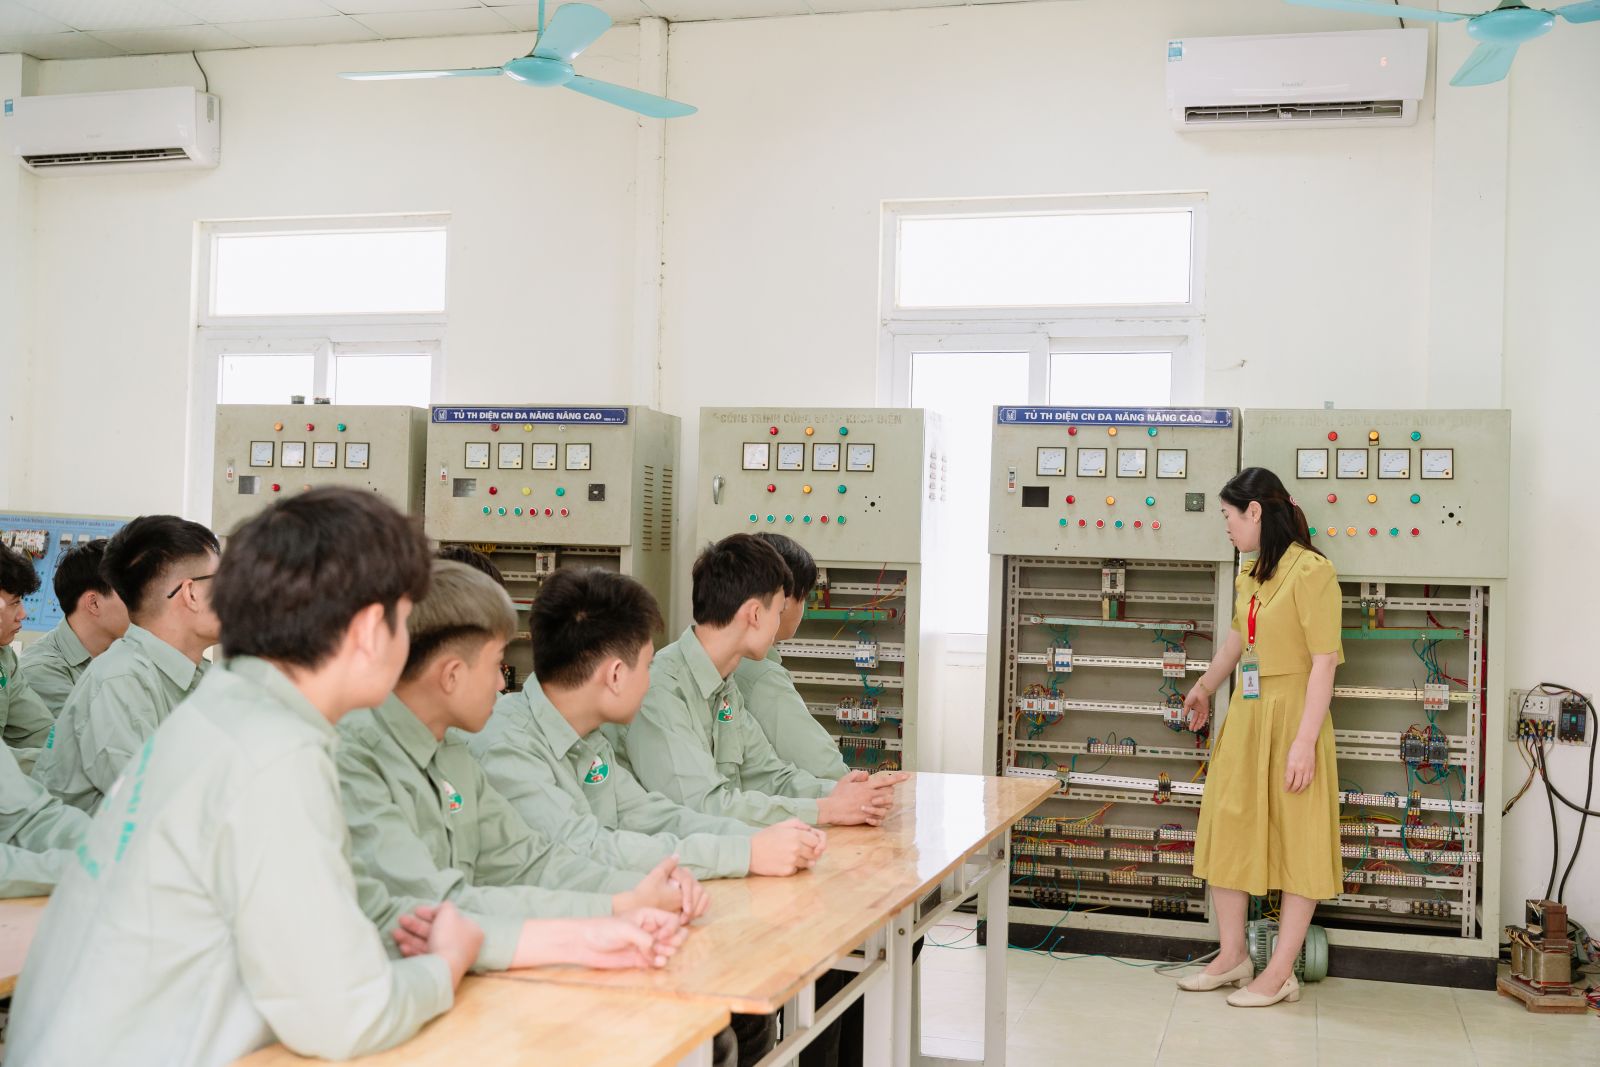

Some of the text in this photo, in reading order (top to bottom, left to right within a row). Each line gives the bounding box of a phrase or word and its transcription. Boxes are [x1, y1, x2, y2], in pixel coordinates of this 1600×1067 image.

[453, 409, 465, 419] TỦ
[467, 411, 478, 419] TH
[479, 410, 500, 421] ĐIỆN
[501, 412, 514, 420] CN
[515, 412, 527, 420] ĐA
[529, 410, 555, 420] NĂNG
[556, 410, 582, 420] NÂNG
[583, 412, 602, 420] CAO
[1024, 409, 1038, 420] TỦ
[1040, 412, 1053, 420] TH
[1055, 410, 1079, 423] ĐIỆN
[1080, 413, 1096, 421] CN
[1097, 413, 1113, 421] ĐA
[1115, 411, 1145, 421] NĂNG
[1147, 411, 1177, 422] NÂNG
[1179, 414, 1202, 422] CAO
